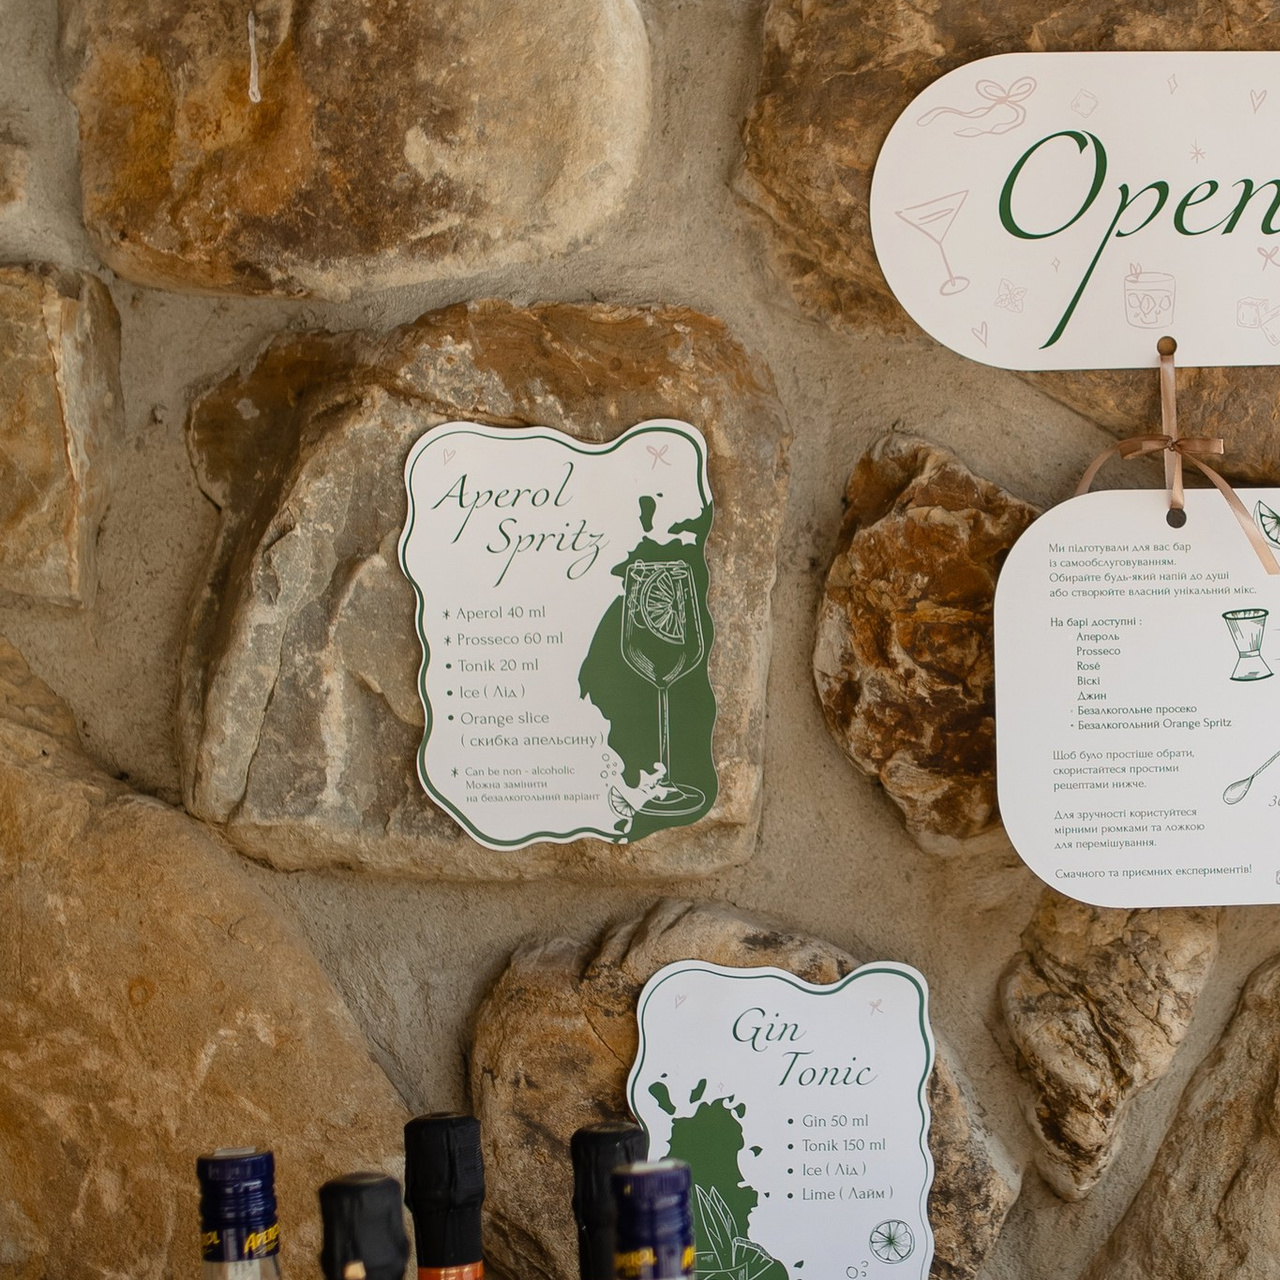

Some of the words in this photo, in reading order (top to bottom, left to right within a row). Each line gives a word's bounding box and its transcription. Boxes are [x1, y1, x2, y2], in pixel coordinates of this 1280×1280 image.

[431, 462, 573, 544] Aperol
[486, 518, 610, 588] Spritz
[1048, 542, 1065, 553] Ми
[1068, 543, 1129, 555] підготували
[1131, 544, 1150, 552] для
[1153, 544, 1170, 552] вас
[1172, 541, 1192, 554] бар
[1049, 558, 1058, 568] із
[1059, 557, 1177, 570] самообслуговуванням.
[1048, 572, 1102, 585] Обирайте
[1103, 572, 1156, 584] будь-який
[1159, 571, 1187, 581] напій
[1189, 573, 1203, 581] до
[1205, 571, 1229, 583] душі
[1049, 588, 1069, 598] або
[1071, 588, 1126, 599] створюйте
[1128, 587, 1171, 596] власний
[1173, 586, 1231, 598] унікальний
[1233, 585, 1257, 594] мікс.
[456, 605, 503, 623] Aperol
[507, 605, 524, 618] 40
[528, 605, 546, 618] ml
[1050, 617, 1064, 627] На
[1066, 617, 1089, 629] барі
[1090, 616, 1136, 629] доступні
[457, 632, 520, 646] Prosseco
[523, 631, 542, 645] 60
[546, 631, 563, 644] ml
[1076, 631, 1120, 644] Апероль
[1076, 646, 1121, 656] Prosseco
[457, 659, 496, 672] Tonik
[499, 658, 517, 671] 20
[521, 657, 538, 671] ml
[1076, 660, 1101, 671] Rosé
[1077, 675, 1101, 686] Віскі
[1077, 691, 1107, 701] Джин
[1077, 705, 1153, 716] Безалкогольне
[1155, 705, 1198, 716] просеко
[460, 711, 514, 728] Orange
[518, 710, 549, 724] slice
[1078, 720, 1160, 730] Безалкогольний
[1162, 718, 1201, 730] Orange
[1203, 718, 1232, 730] Spritz
[1054, 869, 1106, 879] Смачного
[1122, 868, 1173, 879] приємних
[1175, 864, 1252, 877] експериментів!
[732, 1007, 807, 1052] Gin
[779, 1049, 878, 1086] Tonic
[802, 1114, 827, 1128] Gin
[830, 1114, 848, 1127] 50
[852, 1113, 868, 1127] ml
[802, 1138, 839, 1152] Tonik
[843, 1138, 865, 1151] 150
[869, 1137, 886, 1151] ml
